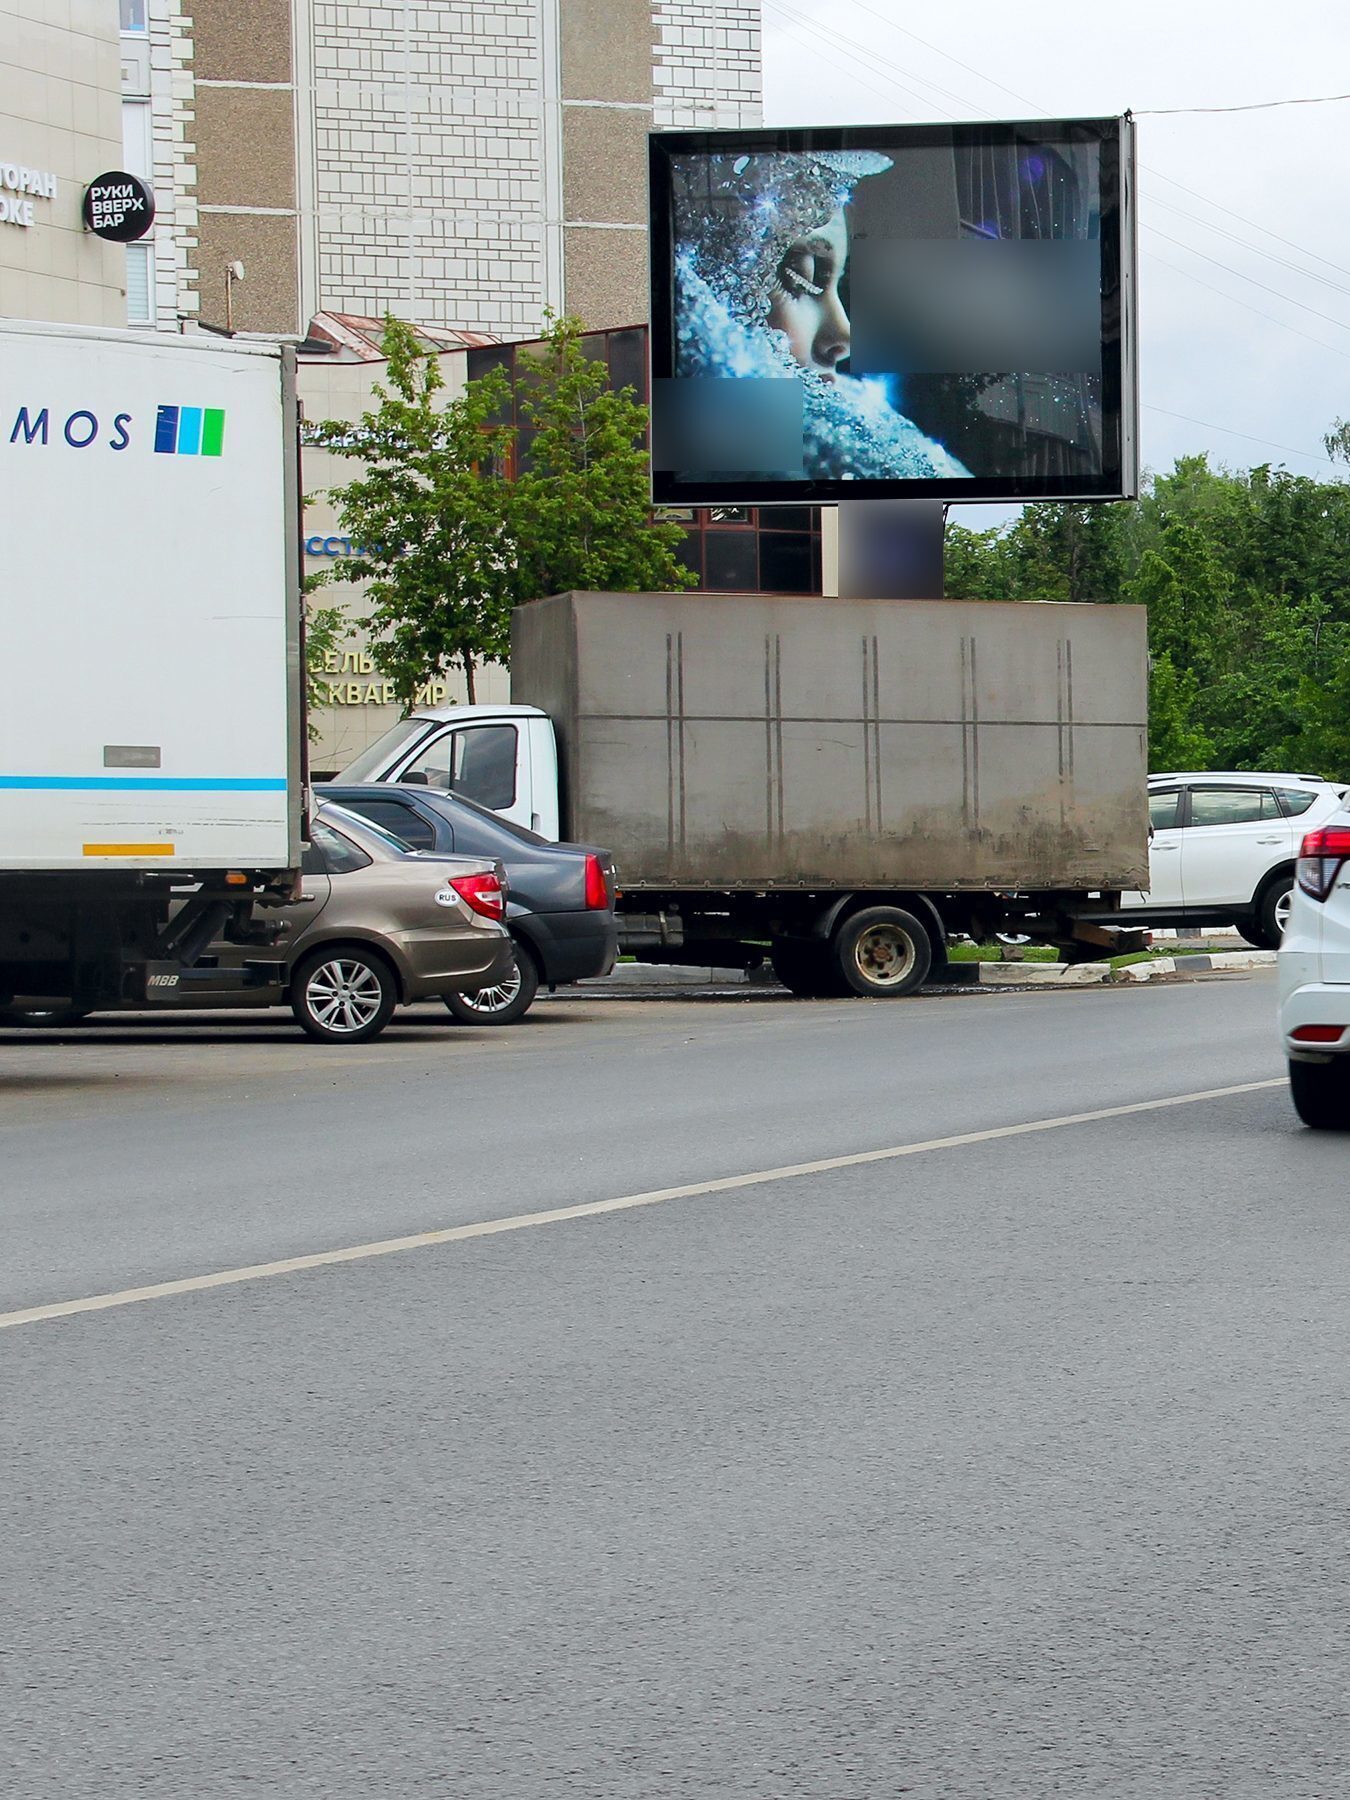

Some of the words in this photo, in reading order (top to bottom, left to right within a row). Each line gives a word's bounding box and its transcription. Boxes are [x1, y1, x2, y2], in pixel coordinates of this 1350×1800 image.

[91, 184, 134, 200] РУКИ
[92, 198, 144, 214] ВВЕРХ
[93, 213, 125, 228] БАР
[10, 406, 132, 451] MOS
[328, 681, 447, 706] КВАРИР
[439, 894, 456, 902] RUS
[147, 975, 179, 986] MBB
